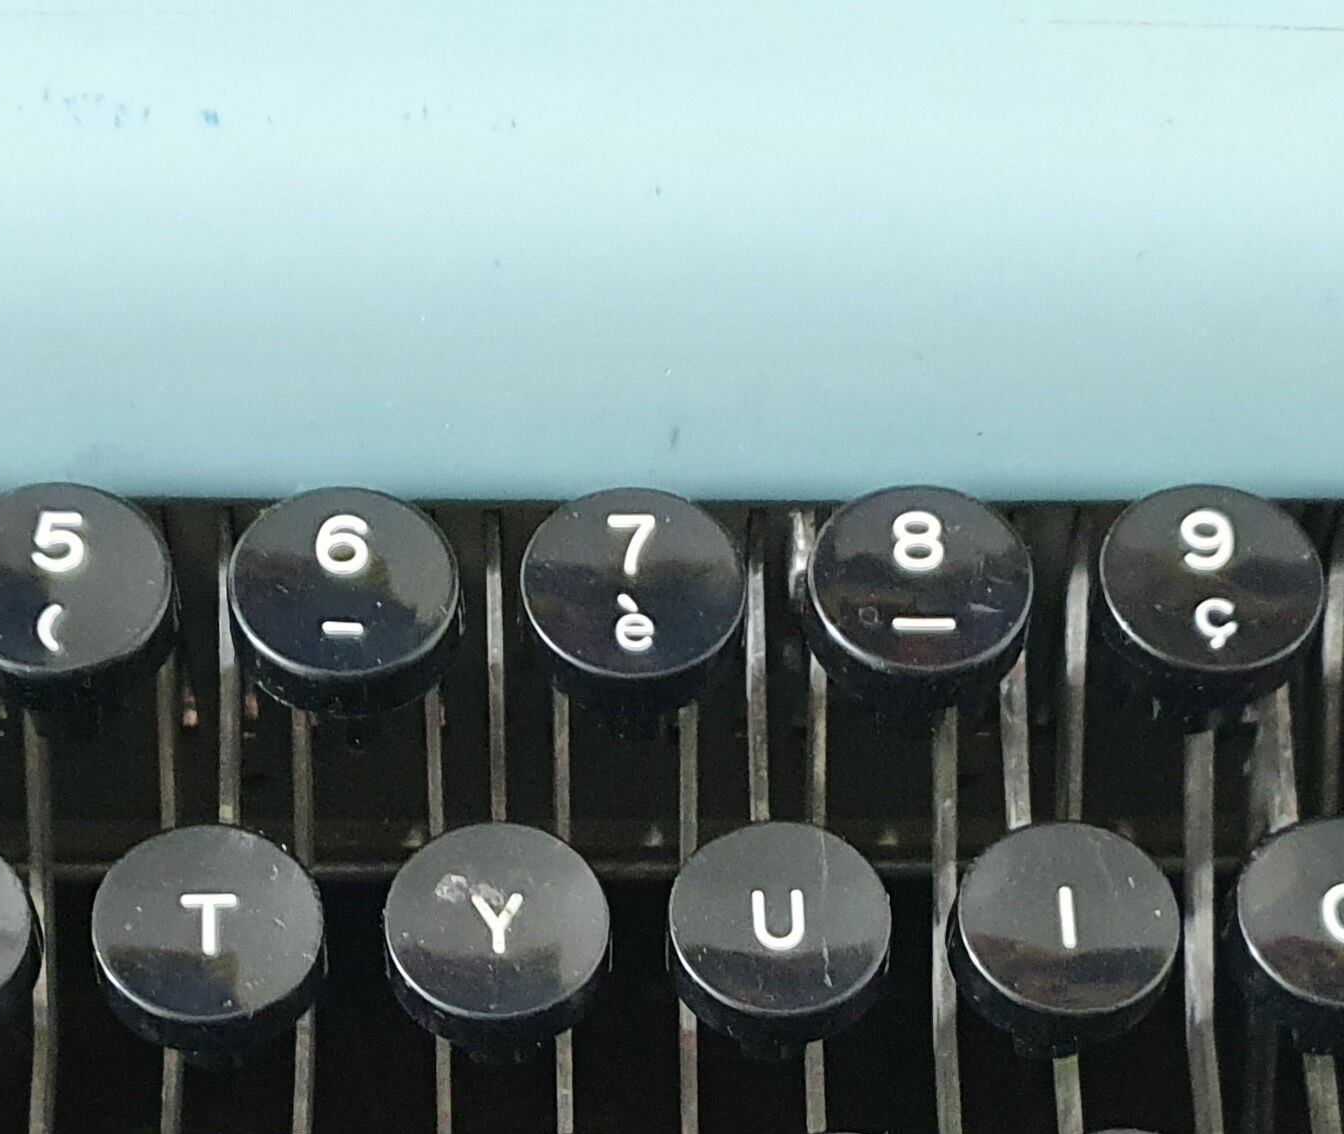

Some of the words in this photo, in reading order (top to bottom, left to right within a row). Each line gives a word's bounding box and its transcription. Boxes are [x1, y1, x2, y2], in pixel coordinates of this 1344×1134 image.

[31, 511, 86, 574] 5
[315, 514, 369, 575] 6
[607, 514, 656, 576] 7
[892, 510, 944, 572] 8
[1179, 509, 1234, 571] 9
[37, 603, 63, 653] (
[615, 593, 655, 652] è
[1194, 597, 1238, 650] ç
[180, 893, 238, 956] T
[471, 891, 524, 954] Y
[751, 889, 805, 951] U
[1058, 886, 1077, 949] I
